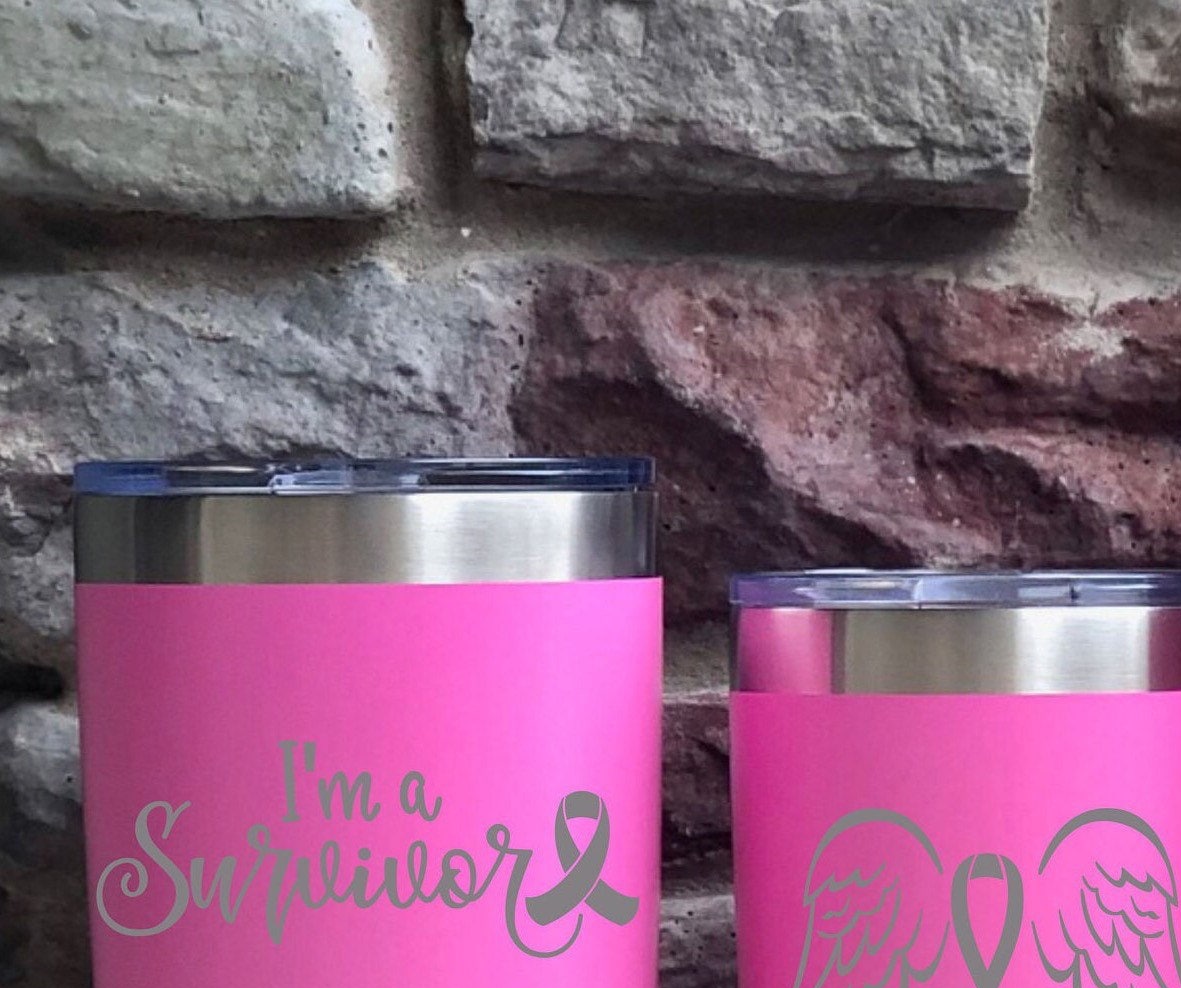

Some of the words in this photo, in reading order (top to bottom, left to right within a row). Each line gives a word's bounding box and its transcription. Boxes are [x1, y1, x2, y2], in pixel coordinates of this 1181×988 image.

[278, 739, 381, 824] I'm
[399, 770, 443, 822] a
[96, 799, 583, 959] Survivor
